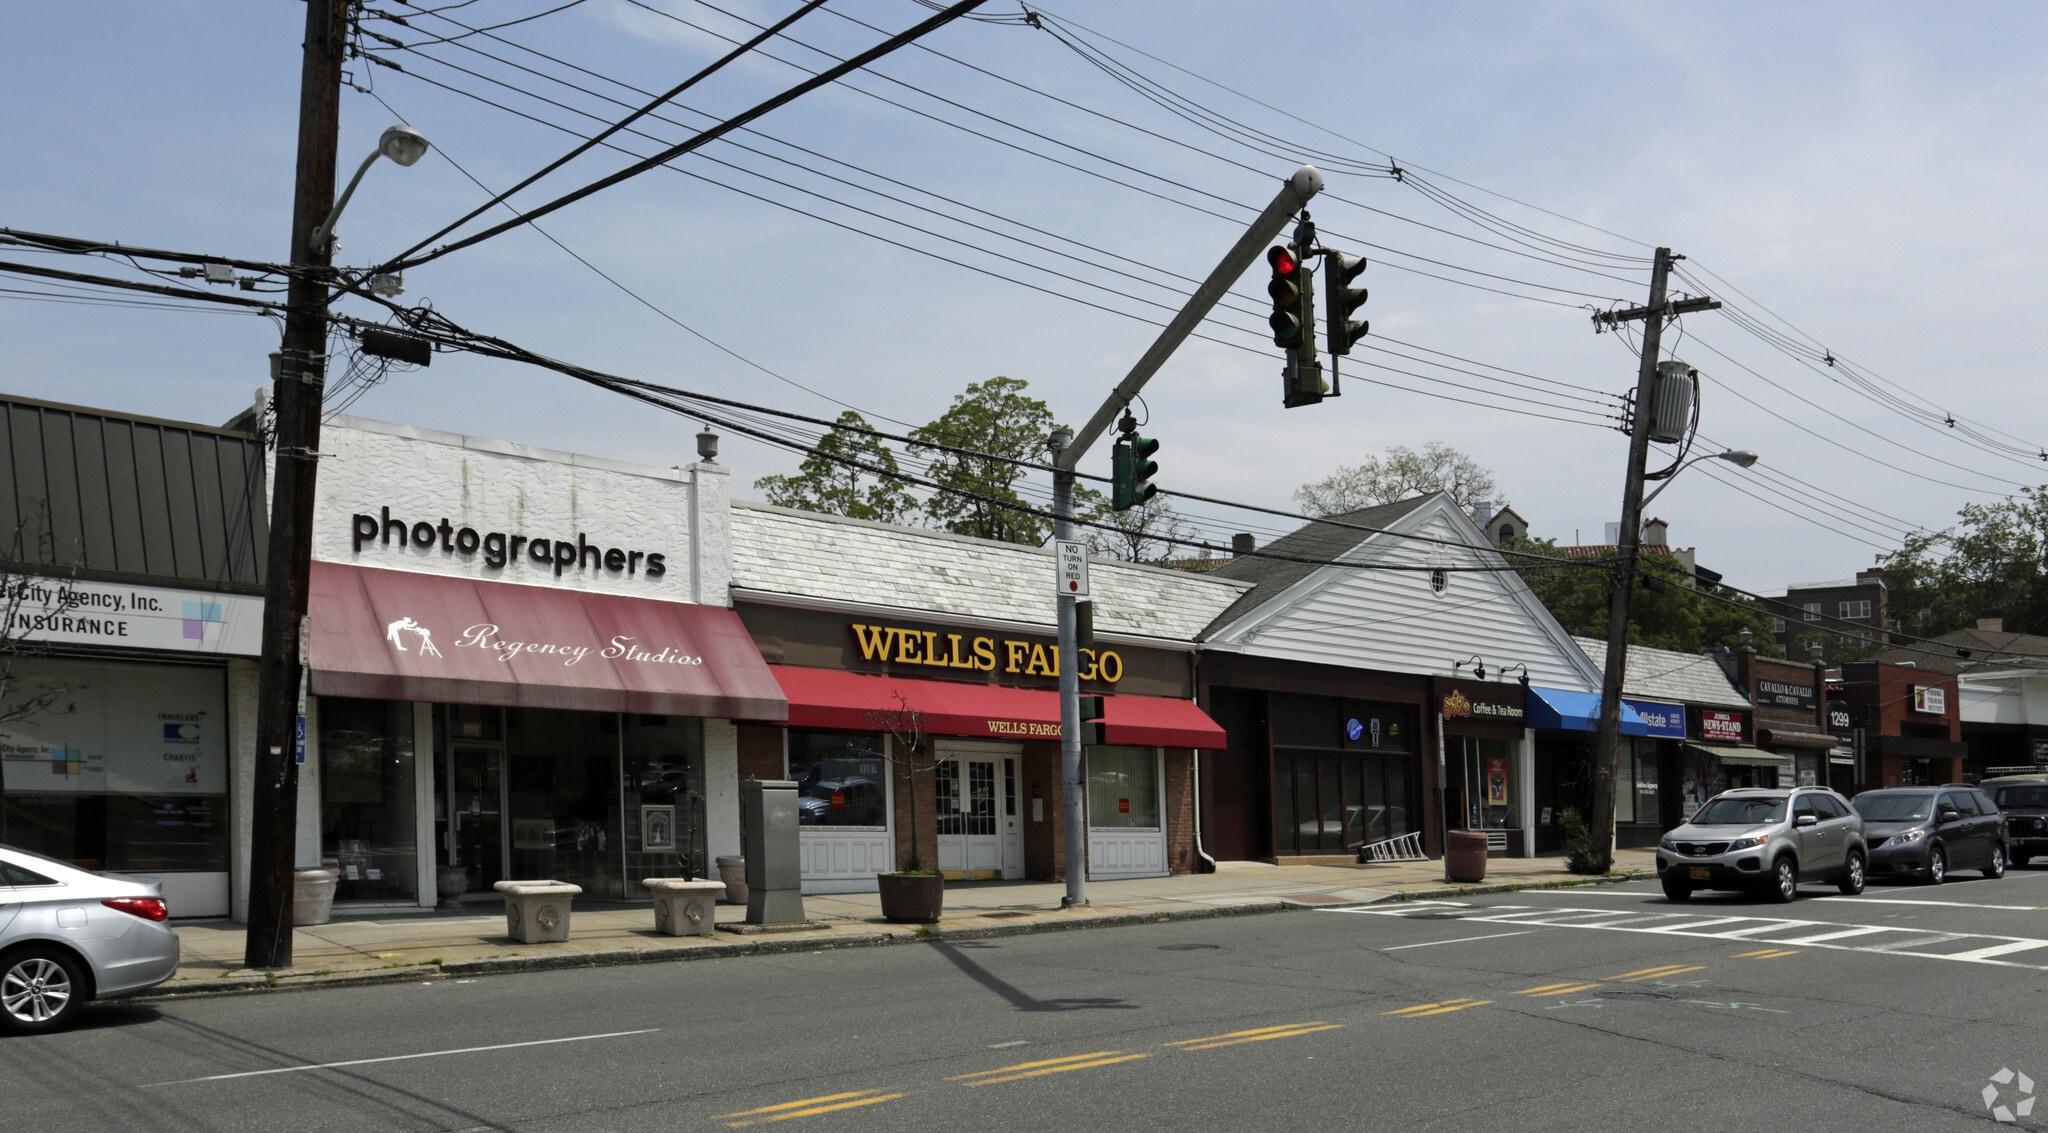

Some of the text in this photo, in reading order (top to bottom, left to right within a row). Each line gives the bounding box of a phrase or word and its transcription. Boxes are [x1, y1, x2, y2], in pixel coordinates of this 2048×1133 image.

[352, 506, 667, 577] photographers
[1065, 545, 1079, 554] NO
[1063, 554, 1083, 563] TURN
[1067, 563, 1078, 571] ON
[1065, 572, 1081, 580] RED
[57, 586, 126, 611] Agency,
[131, 592, 163, 612] Inc.
[11, 613, 128, 637] INSURANCE
[454, 622, 702, 666] Regency Studios
[851, 623, 997, 672] WELLS
[1760, 681, 1784, 694] CAVALLO
[1789, 685, 1812, 698] CAVALLO
[1473, 702, 1523, 717] Coffee & Tea Room
[157, 713, 199, 722] TRAVELERS
[1831, 711, 1849, 727] 1299
[987, 720, 1027, 734] WELLS
[1703, 719, 1741, 732] NEWS-STAND
[163, 753, 196, 762] CHARTIS
